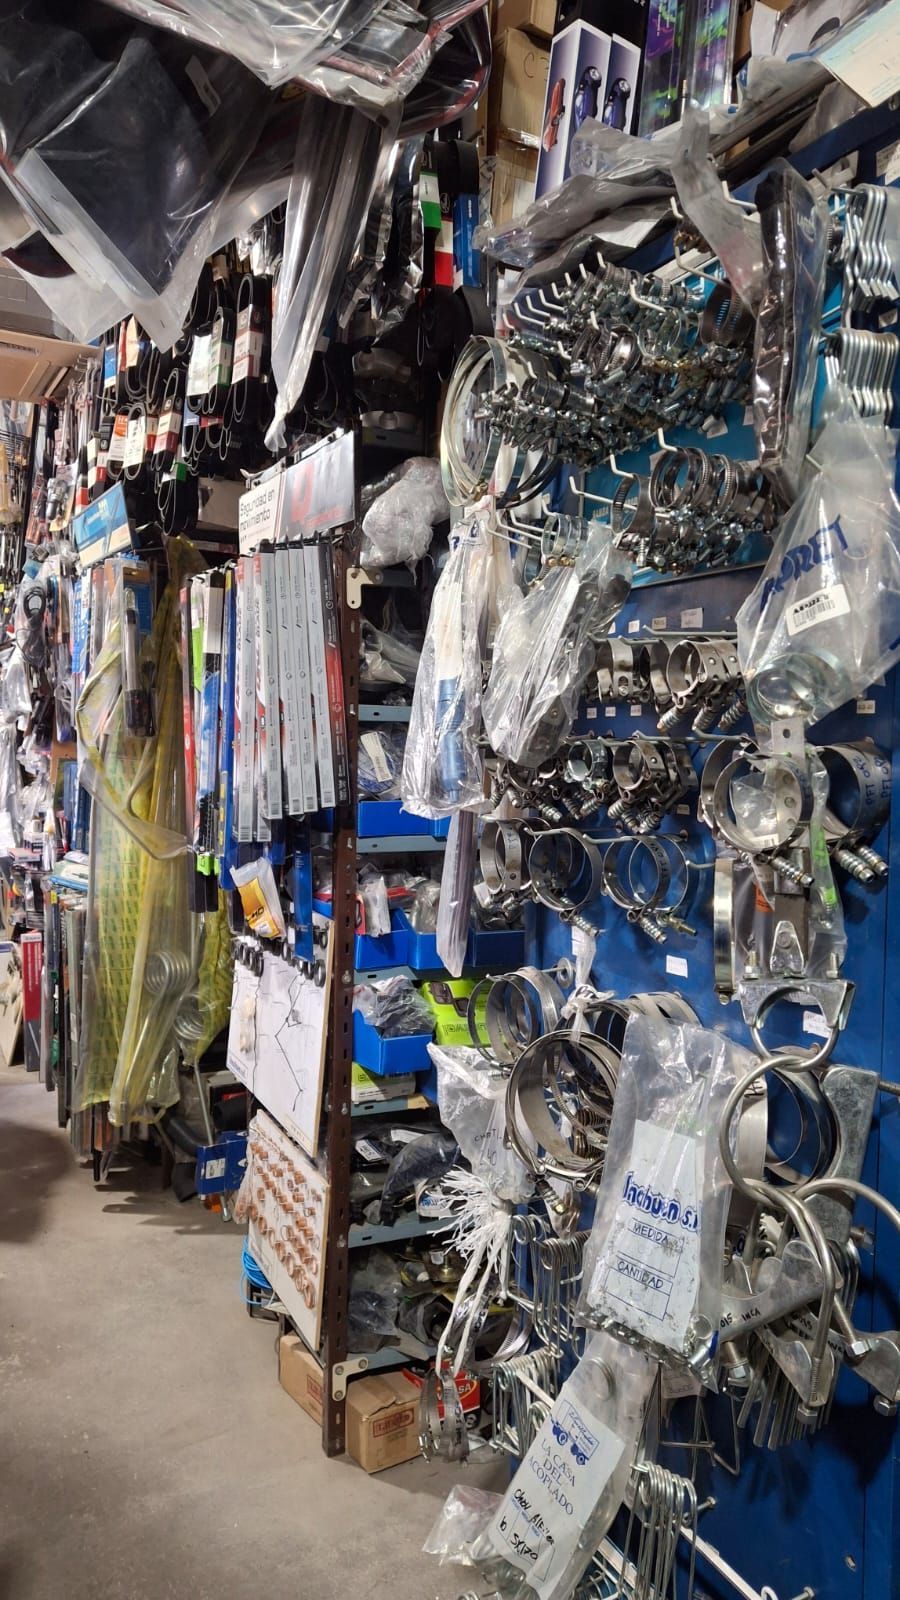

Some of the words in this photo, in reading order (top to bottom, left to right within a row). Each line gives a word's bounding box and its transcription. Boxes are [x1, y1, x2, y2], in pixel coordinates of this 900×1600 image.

[240, 488, 267, 518] Seguridad
[240, 507, 271, 532] movimiento
[633, 1222, 669, 1244] MEDIDA
[617, 1260, 664, 1289] CANTIDAD
[543, 1459, 564, 1487] DEL
[552, 1453, 577, 1488] CASA
[528, 1455, 574, 1516] ACOPLADO
